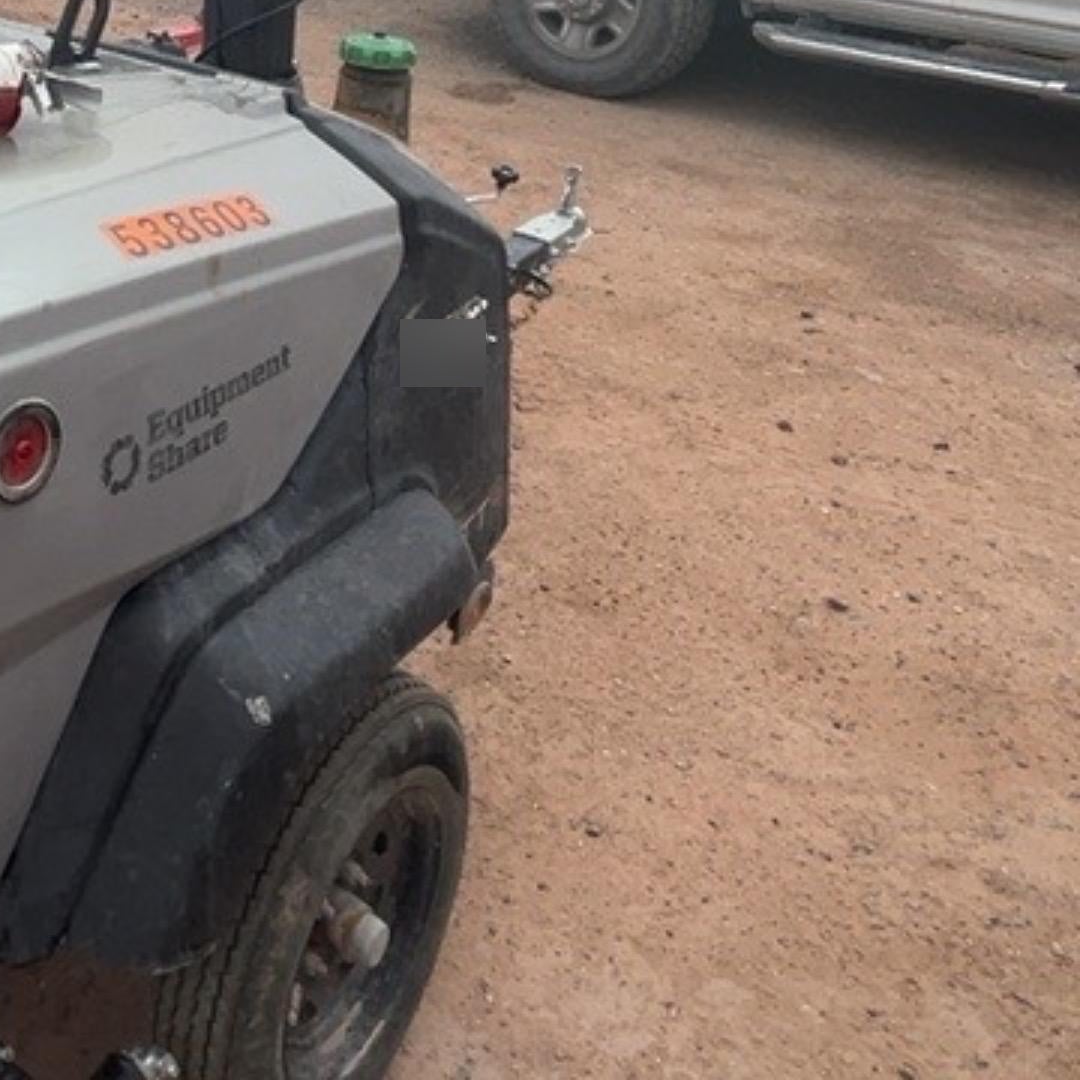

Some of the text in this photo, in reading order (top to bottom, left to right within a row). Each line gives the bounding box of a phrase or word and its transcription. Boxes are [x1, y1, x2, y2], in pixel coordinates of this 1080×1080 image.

[109, 195, 271, 257] 538603
[146, 344, 291, 445] Equipment
[146, 419, 229, 482] Share
